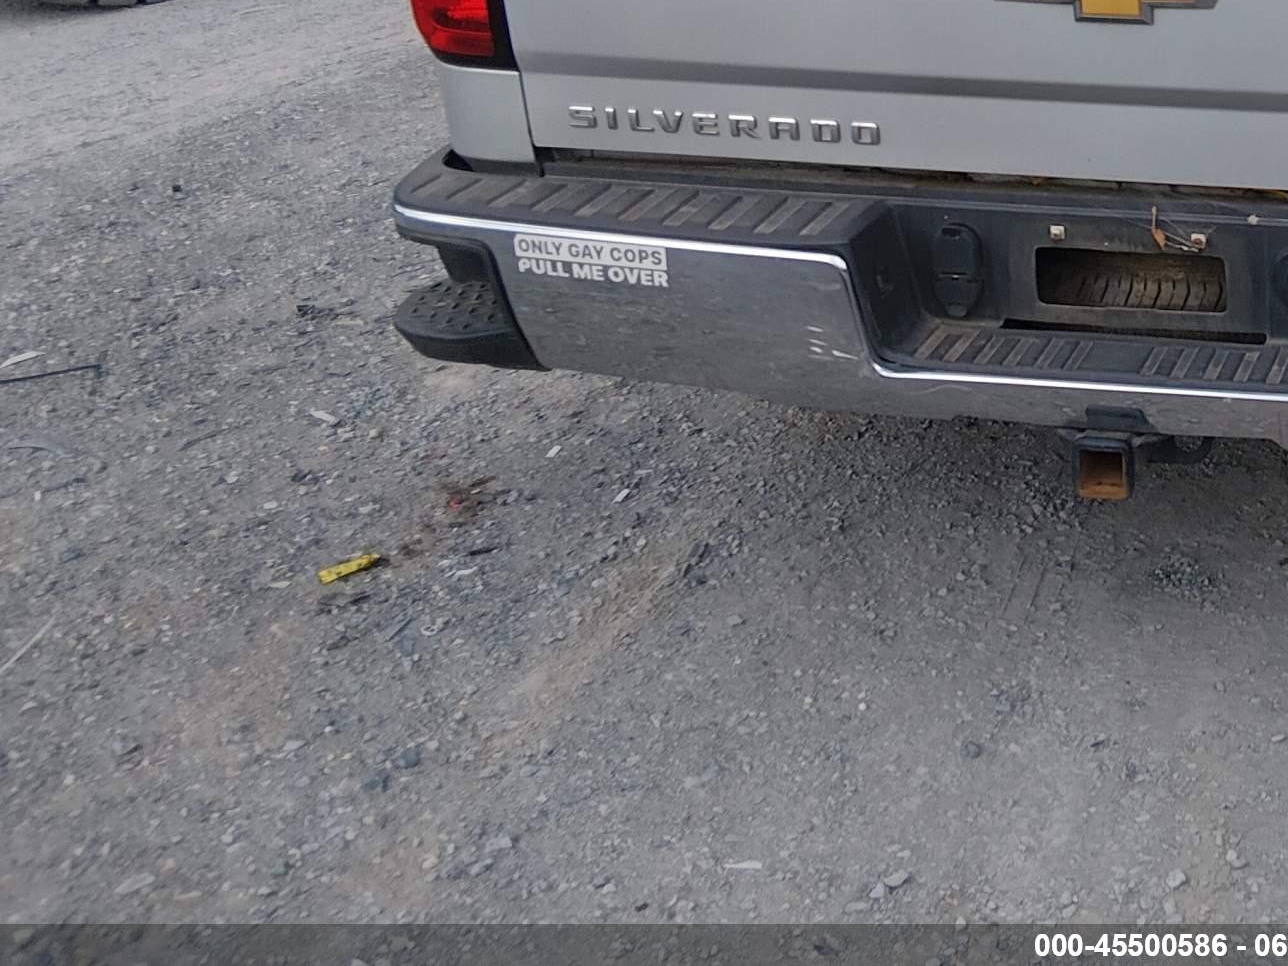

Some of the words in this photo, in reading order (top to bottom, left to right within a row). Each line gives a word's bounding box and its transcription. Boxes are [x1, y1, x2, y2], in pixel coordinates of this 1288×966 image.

[568, 105, 881, 146] SILVERADO
[518, 238, 562, 256] ONLY
[568, 243, 603, 260] GAY
[610, 247, 662, 266] COPS
[518, 258, 570, 278] PULL
[571, 263, 605, 281] ME
[607, 267, 669, 287] OVER
